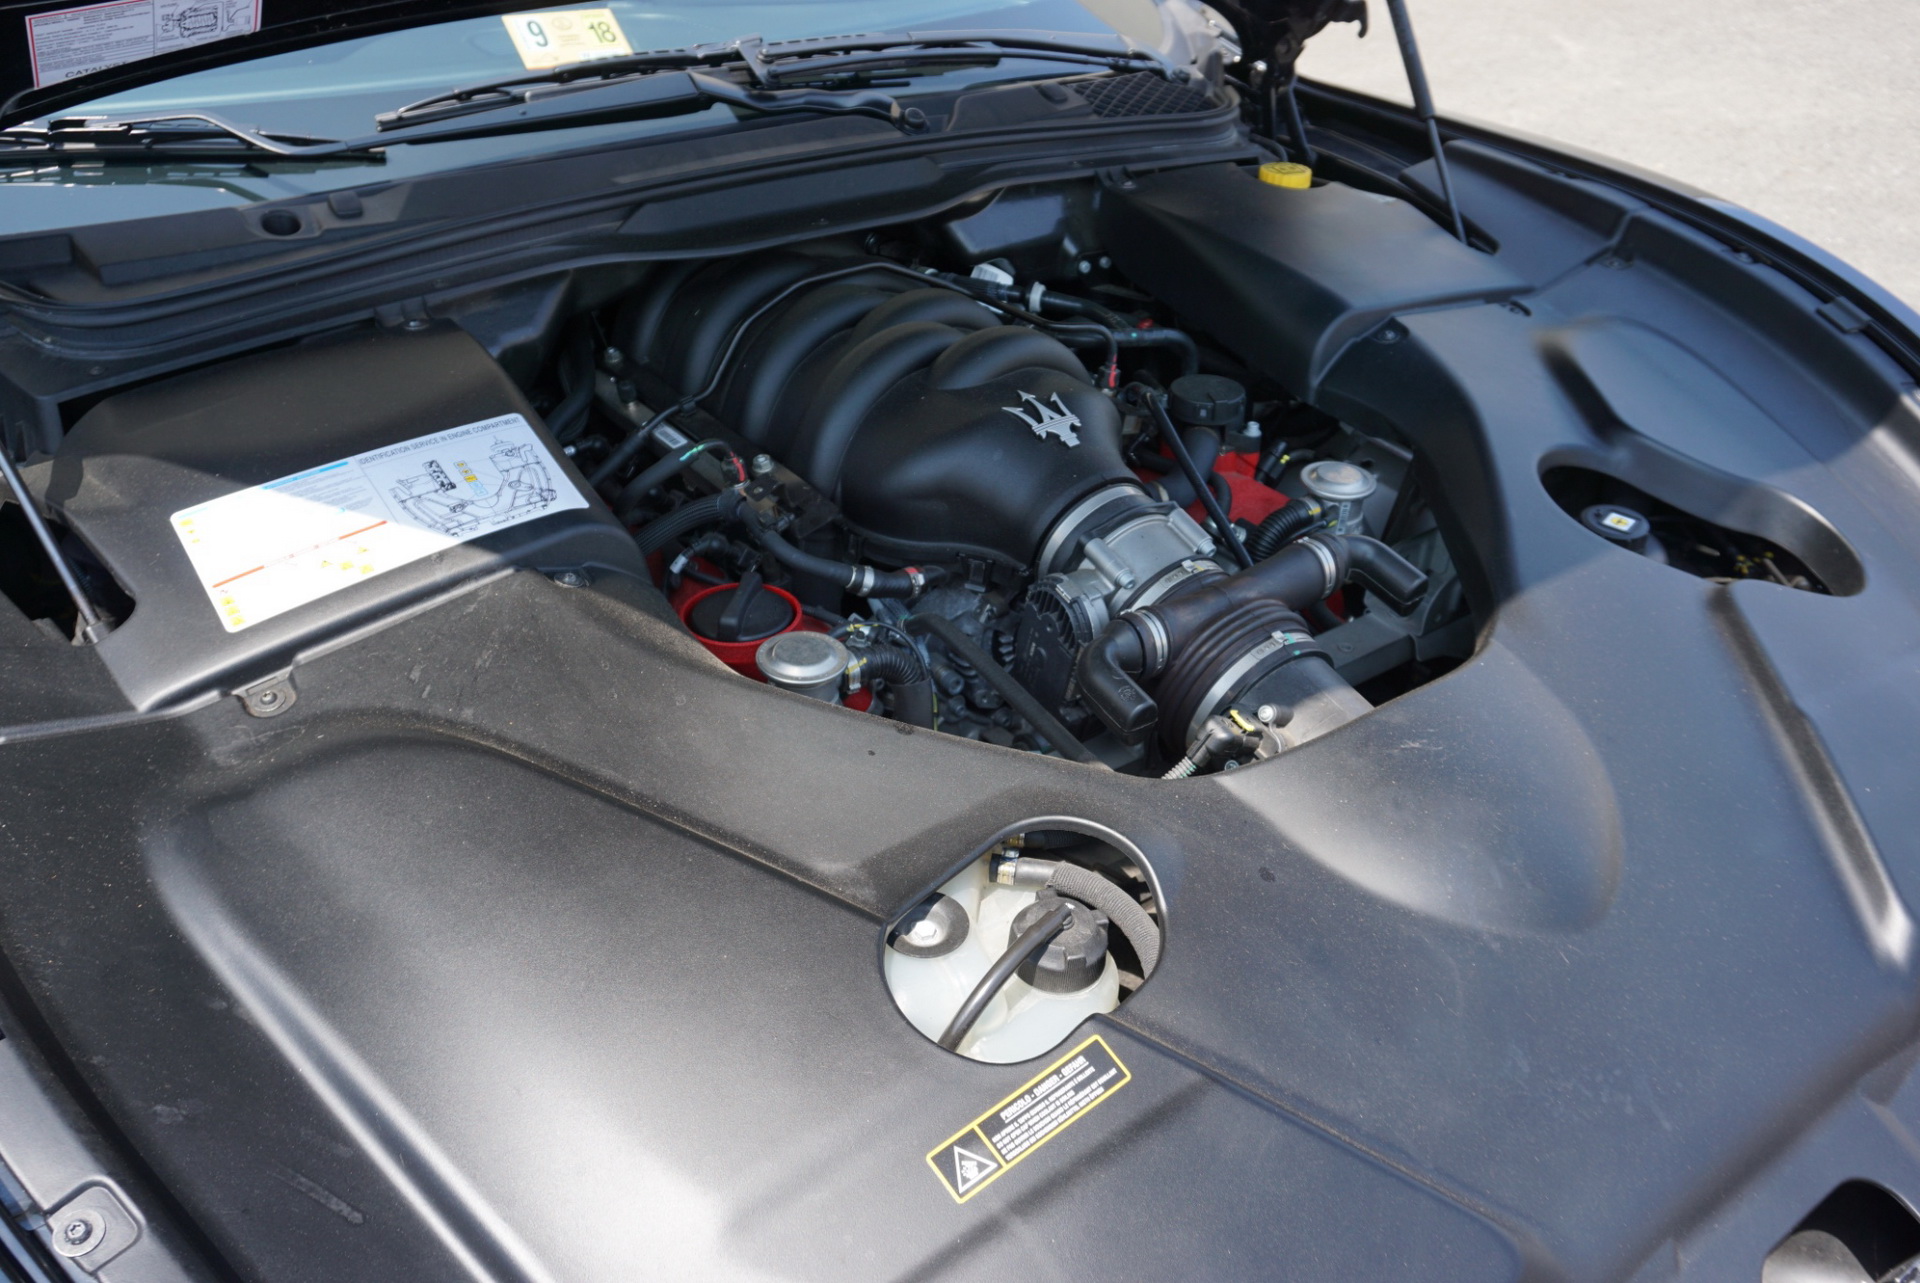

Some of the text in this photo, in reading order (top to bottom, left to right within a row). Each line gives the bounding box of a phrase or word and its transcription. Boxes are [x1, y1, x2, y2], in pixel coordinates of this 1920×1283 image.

[526, 19, 549, 47] 9
[588, 21, 616, 43] 18
[410, 437, 439, 450] SERVICE
[449, 429, 473, 440] ENGINE
[472, 417, 521, 434] COMPARTMENT
[1000, 1094, 1032, 1120] PERICOLO
[1033, 1074, 1060, 1096] DANGER
[1060, 1055, 1087, 1076] GEFAHR
